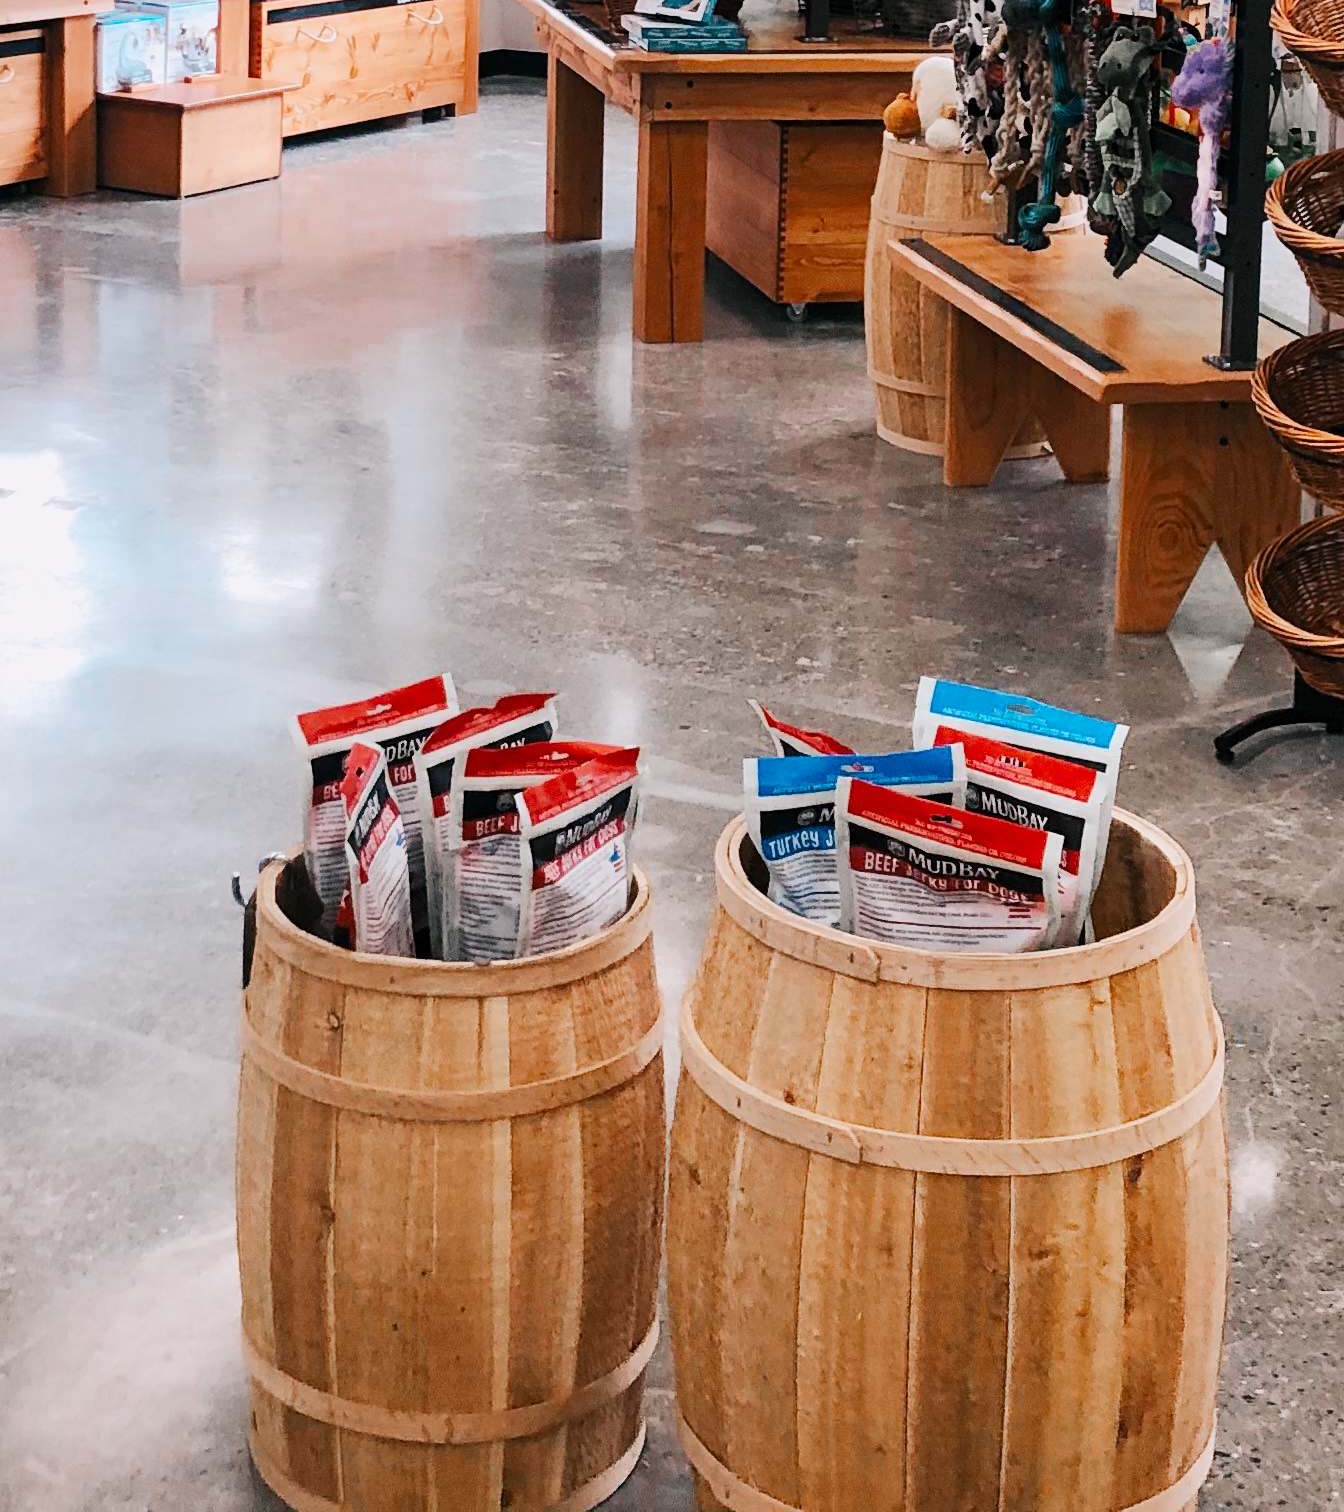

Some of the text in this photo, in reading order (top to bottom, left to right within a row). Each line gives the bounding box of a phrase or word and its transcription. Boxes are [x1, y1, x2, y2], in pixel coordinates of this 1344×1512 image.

[981, 791, 1049, 831] MUDBAY
[475, 817, 506, 837] BEEF
[864, 851, 900, 873] BEEF
[908, 848, 1000, 881] MUDBAY
